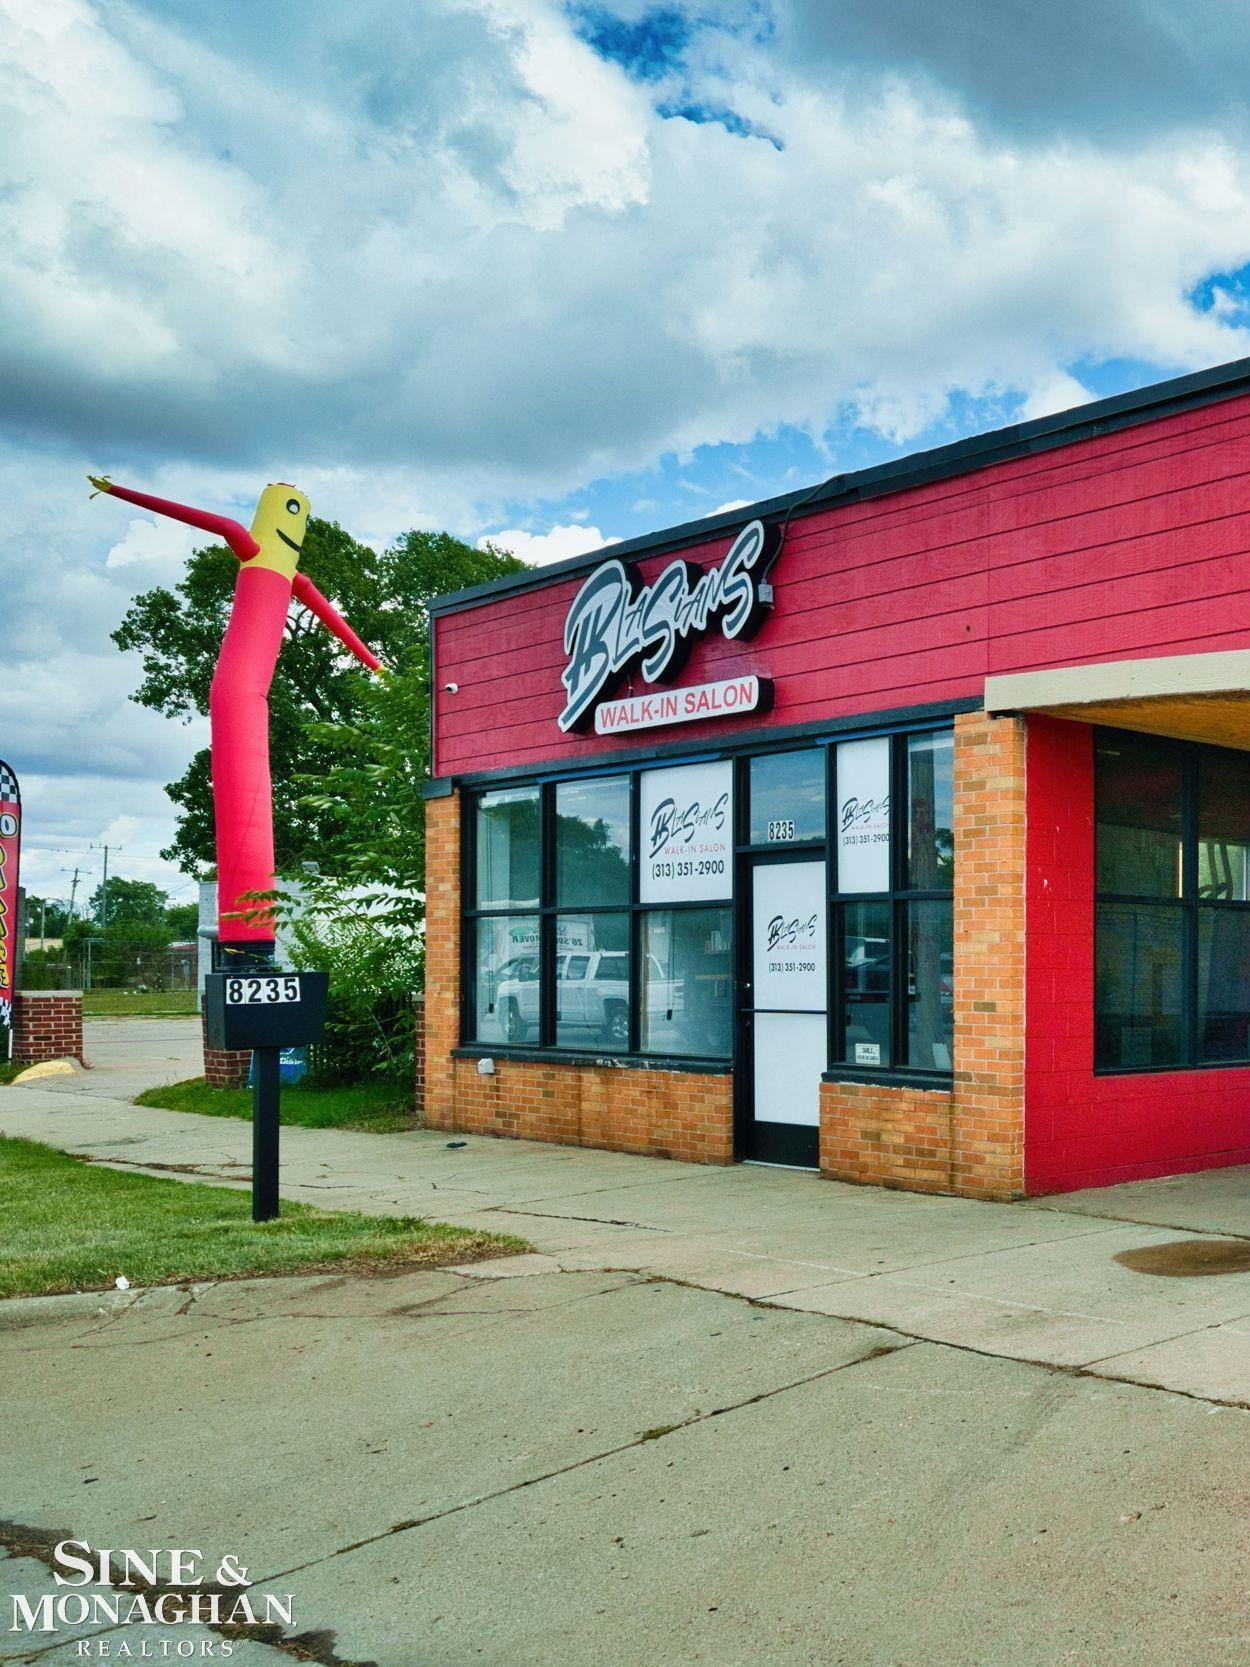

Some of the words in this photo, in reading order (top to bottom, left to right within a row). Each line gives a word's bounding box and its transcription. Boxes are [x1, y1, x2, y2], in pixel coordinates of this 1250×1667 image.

[600, 700, 678, 729] WALK-IN
[684, 682, 754, 714] SALON
[769, 821, 794, 840] 8235
[664, 845, 697, 855] WALK-IN
[699, 843, 726, 853] SALON
[842, 835, 858, 847] (313)
[652, 862, 675, 880] (313)
[677, 860, 725, 876] 351-2900
[768, 962, 784, 973] (313)
[785, 962, 816, 972] 351-2900
[229, 978, 298, 1003] 8235
